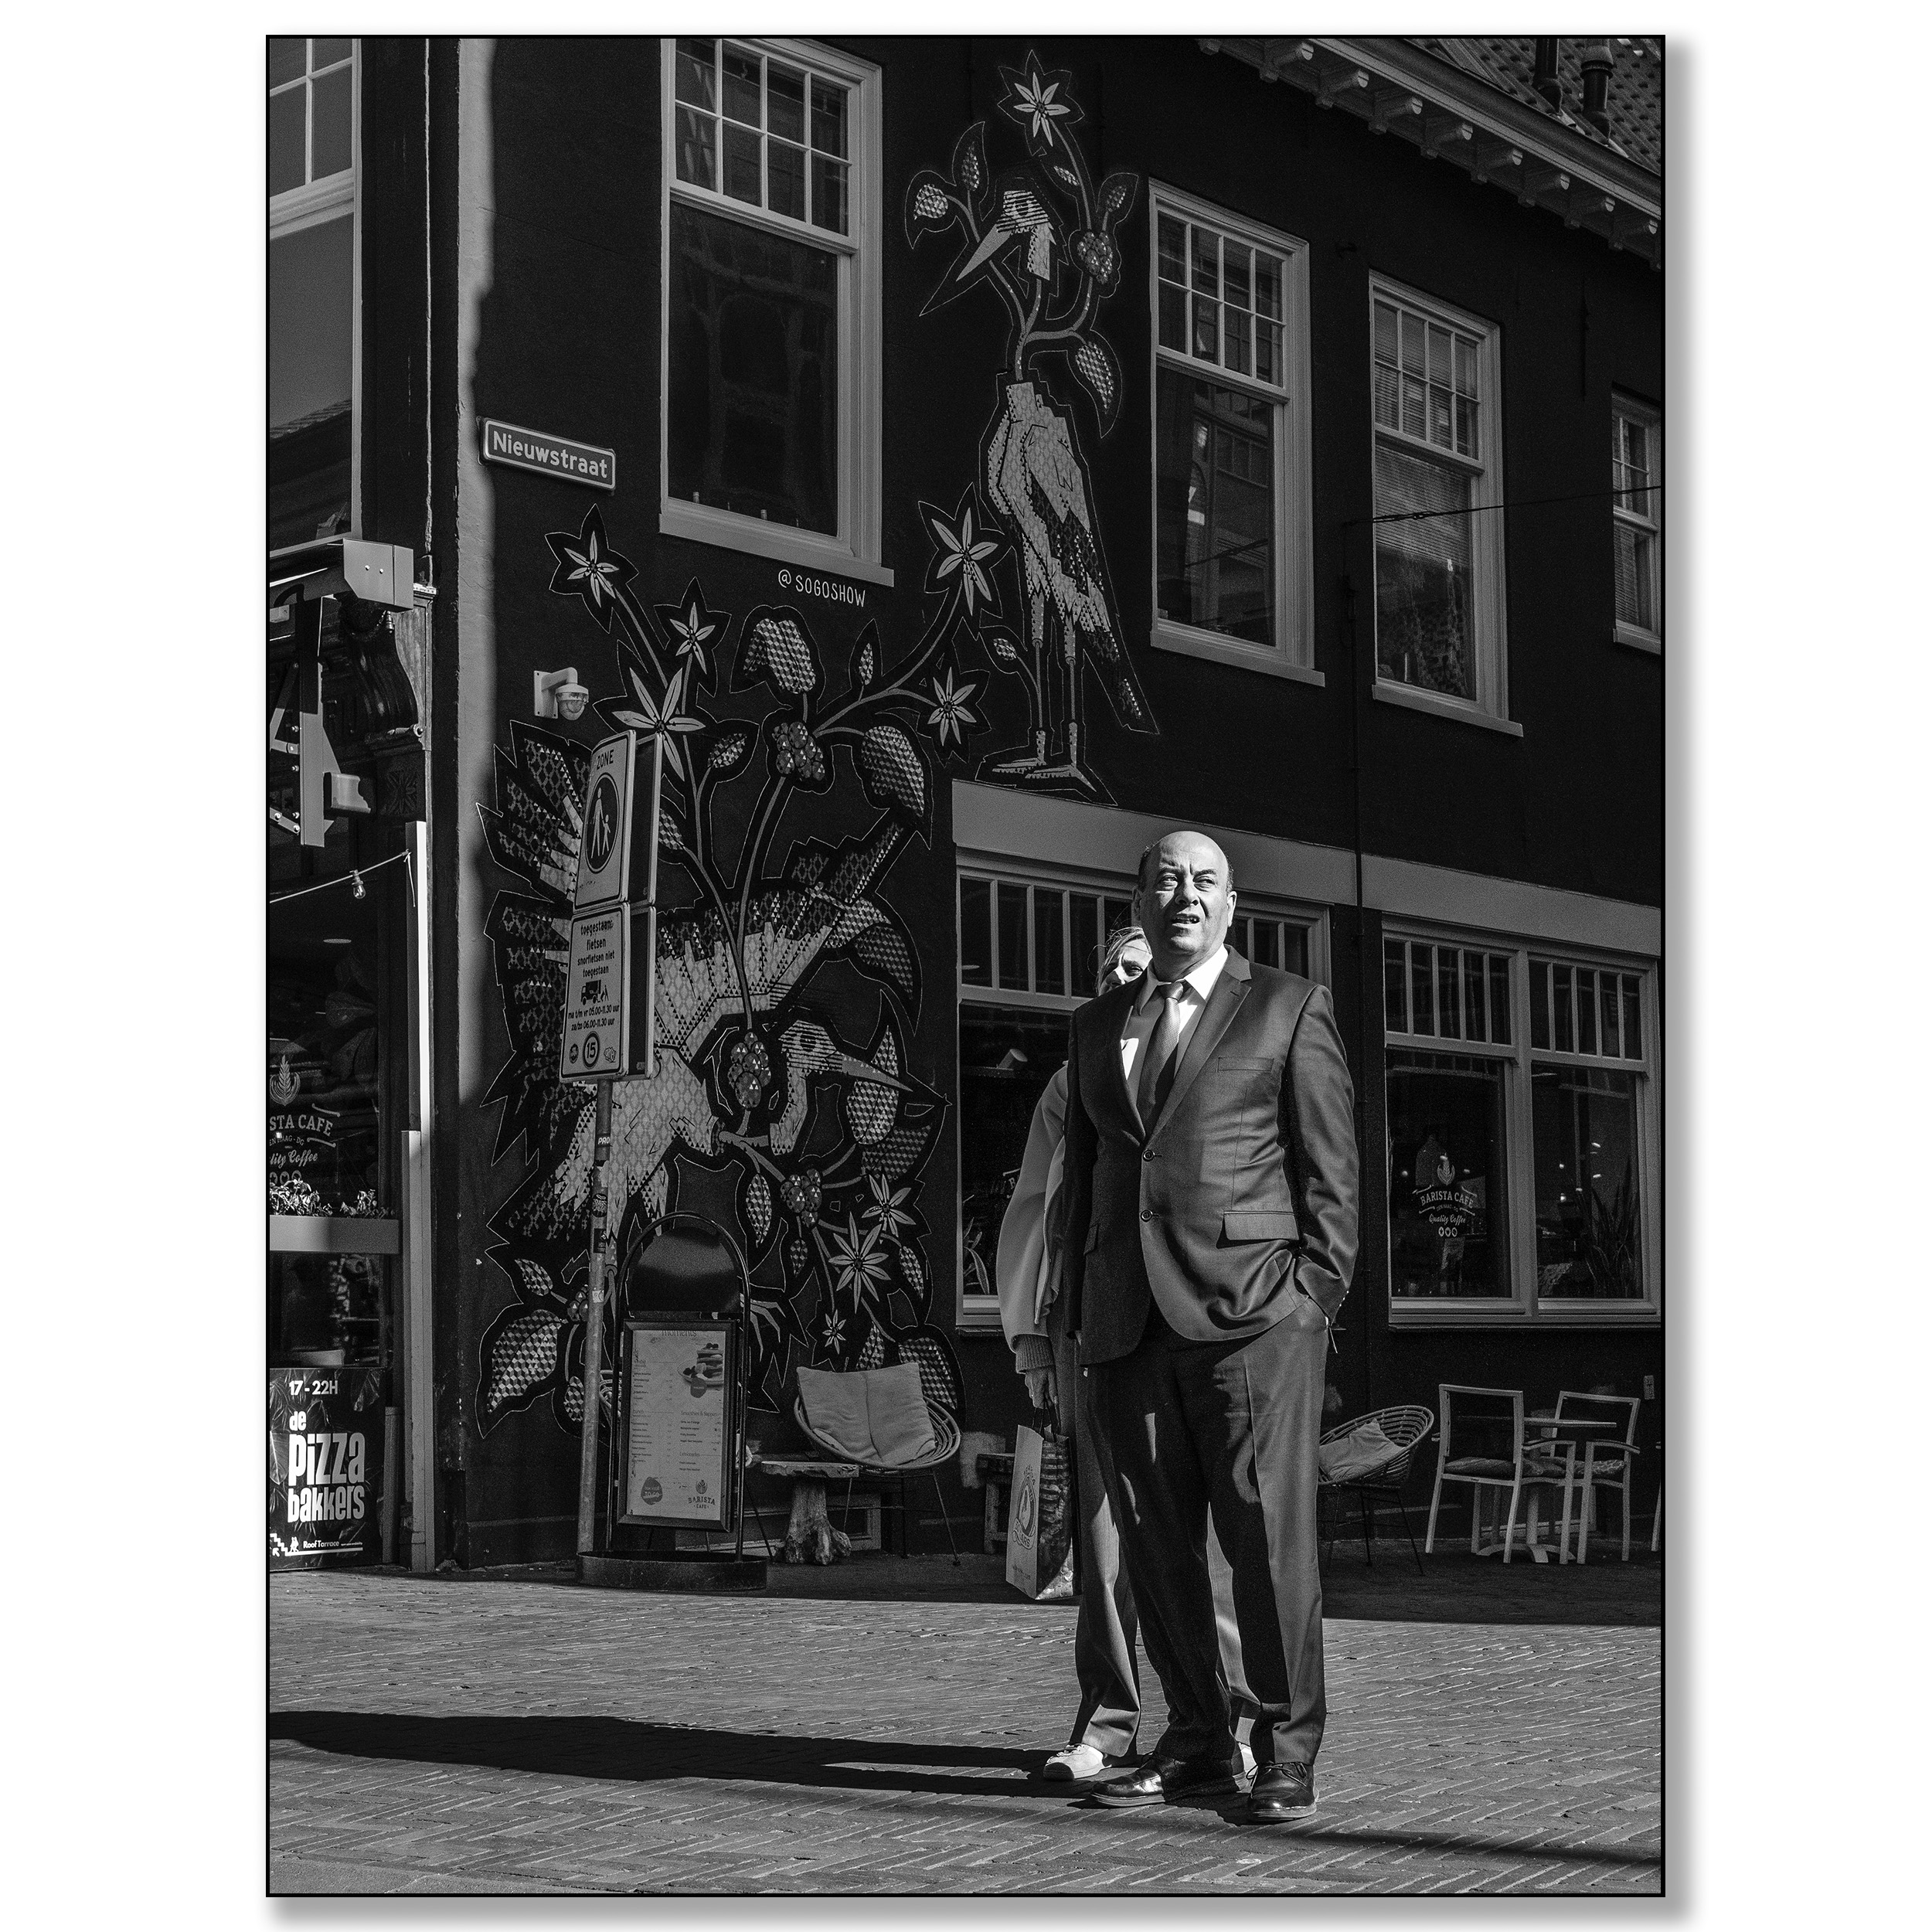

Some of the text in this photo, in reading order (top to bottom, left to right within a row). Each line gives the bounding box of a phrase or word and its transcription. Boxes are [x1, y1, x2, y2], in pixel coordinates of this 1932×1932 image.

[493, 430, 607, 478] Nieuwstraat
[778, 569, 866, 607] @ SOGOSHOW
[597, 749, 614, 770] ZONE
[587, 938, 607, 951] fietsen
[577, 949, 615, 966] snorfietsen niet
[583, 966, 609, 979] toegestaan
[587, 1042, 596, 1059] 15
[298, 1114, 333, 1137] CAFE
[287, 1149, 318, 1167] Coffee
[1420, 1191, 1453, 1206] BARISTA
[1454, 1192, 1474, 1209] CAFE
[1429, 1213, 1466, 1226] Quality Coffee
[289, 1379, 304, 1396] 17
[311, 1379, 338, 1395] 22H
[289, 1410, 307, 1431] de
[287, 1485, 365, 1522] bakkers
[688, 1496, 716, 1505] BARISTA
[303, 1540, 317, 1549] Roof
